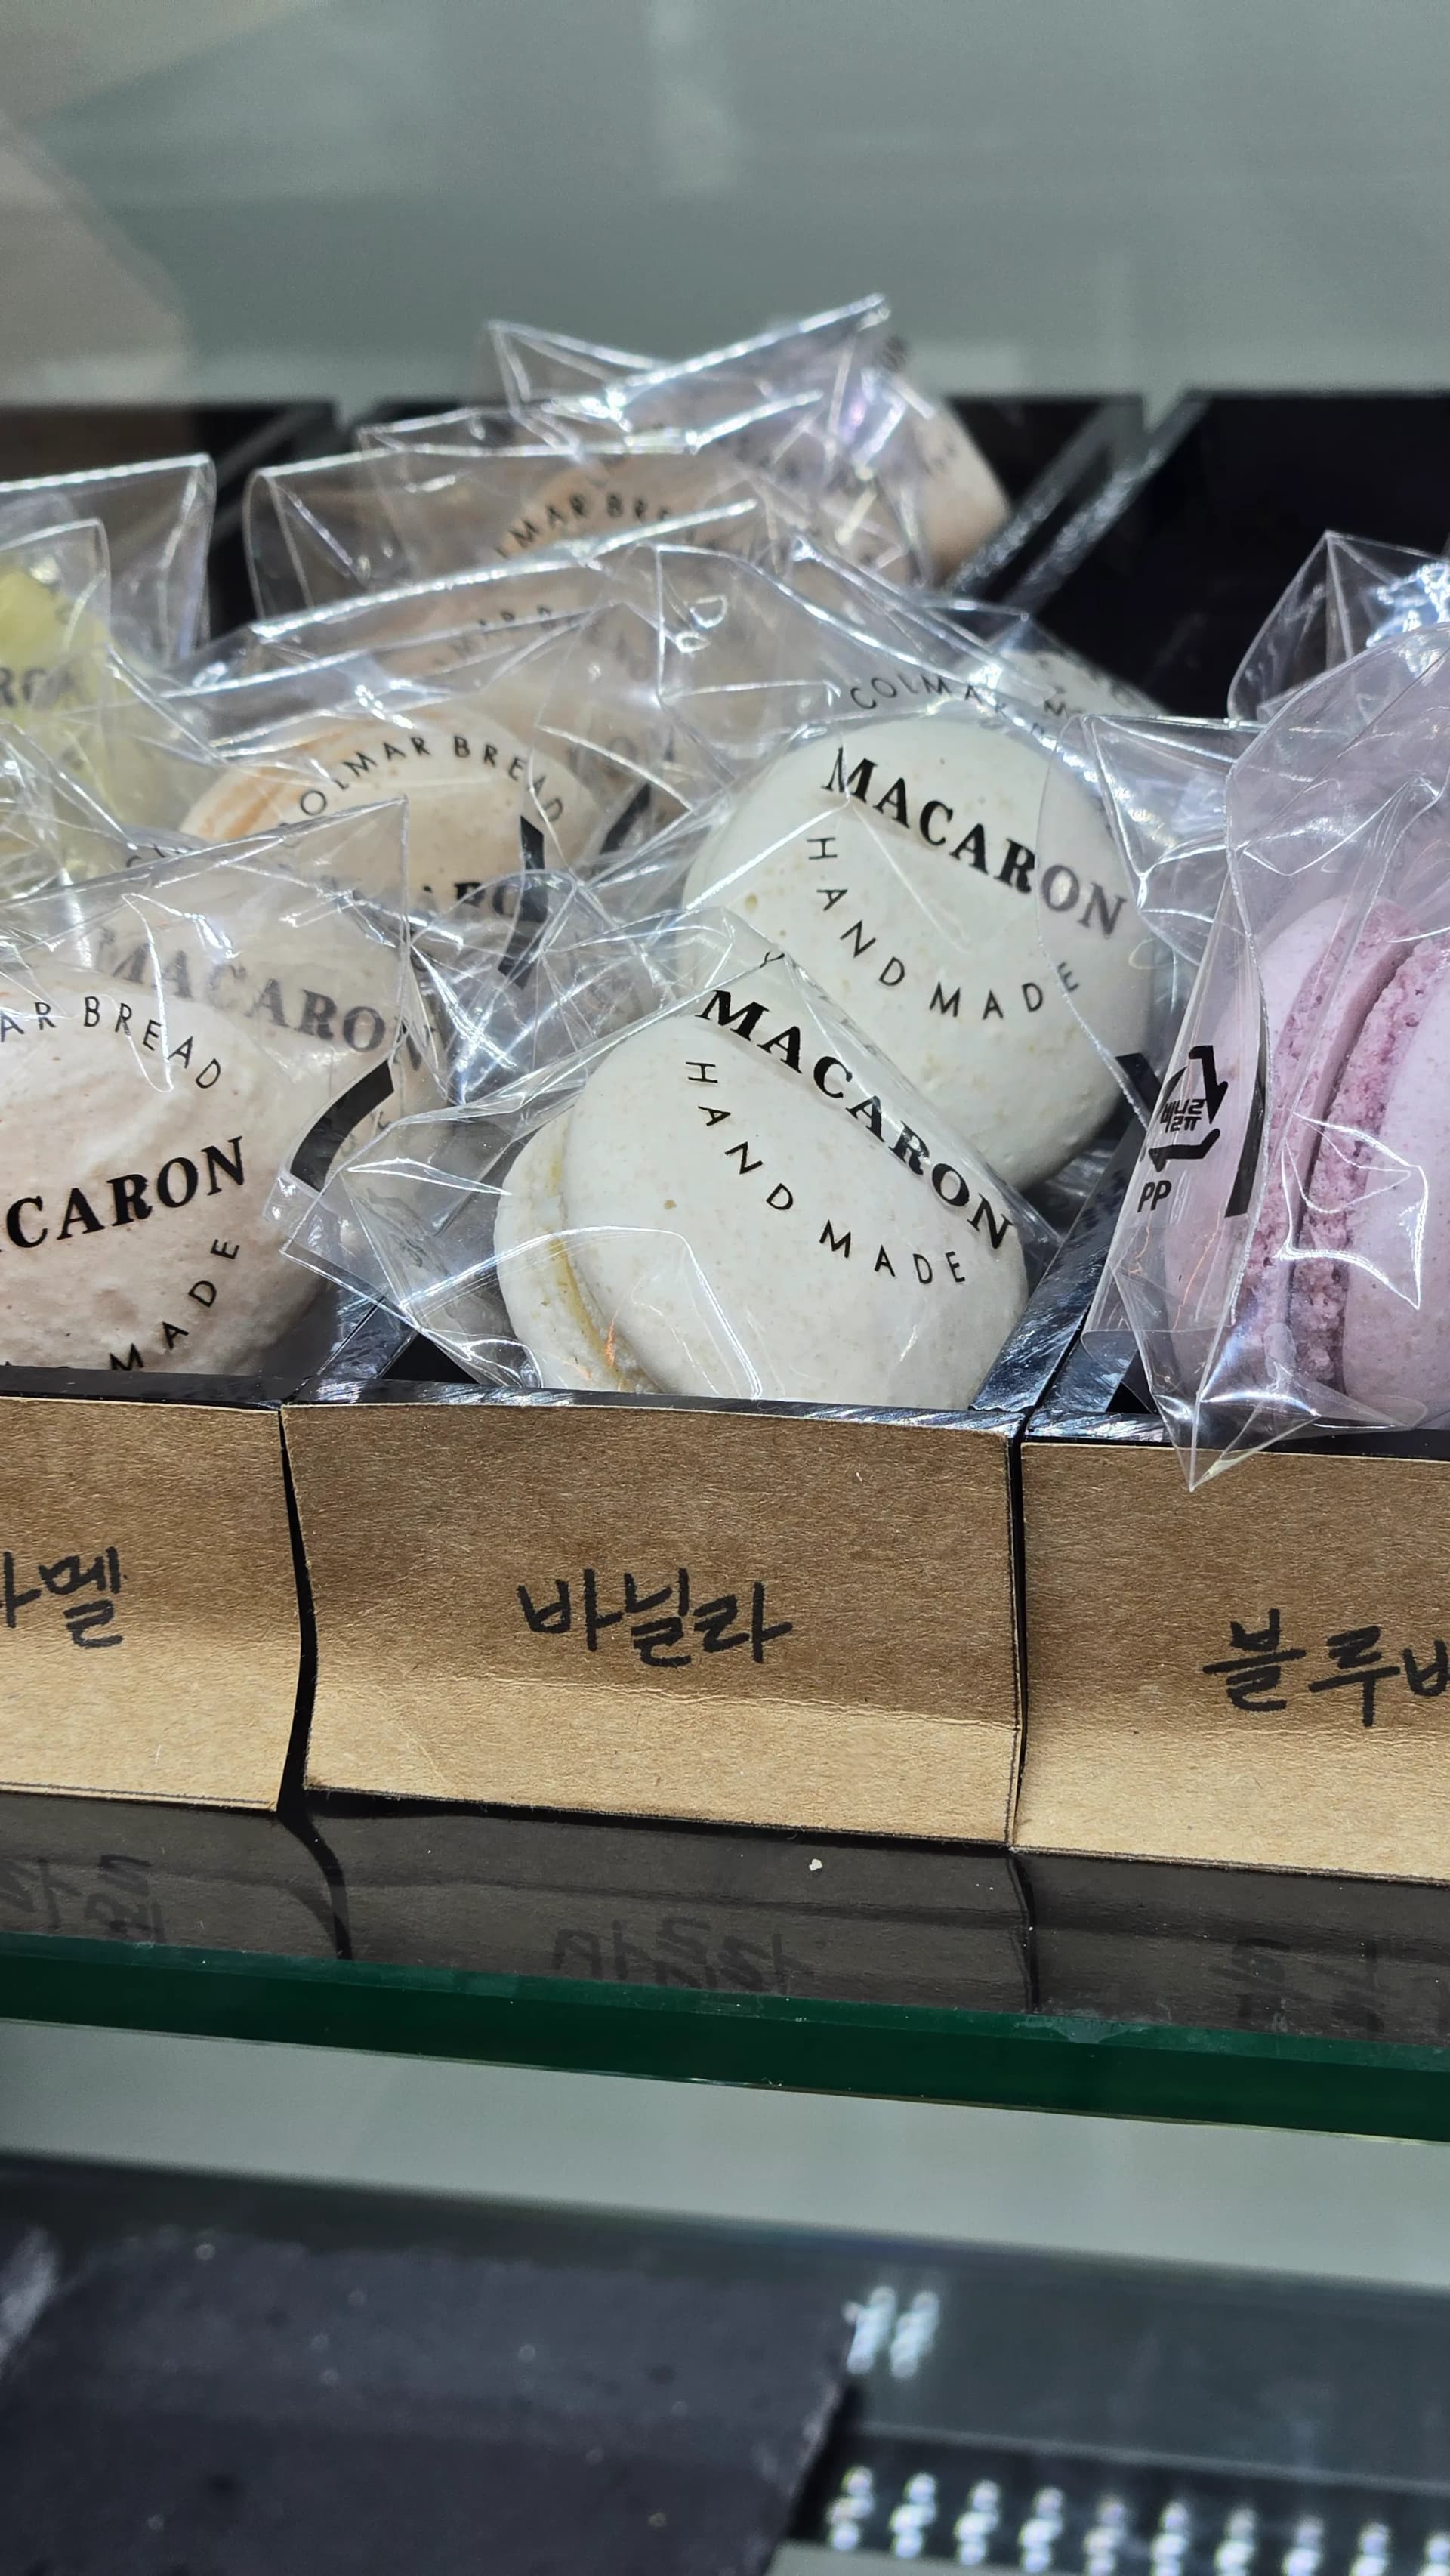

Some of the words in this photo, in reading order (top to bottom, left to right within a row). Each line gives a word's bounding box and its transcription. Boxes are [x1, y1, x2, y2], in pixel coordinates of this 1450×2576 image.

[821, 746, 1128, 939] MACARON
[806, 836, 905, 987] HAND
[929, 962, 1080, 1020] MADE
[83, 996, 221, 1089] BREAD
[695, 989, 1013, 1249] MACARON
[686, 1061, 794, 1212] HAND
[819, 1219, 966, 1284] MADE
[1137, 1180, 1172, 1213] PP
[110, 1239, 240, 1371] MADE
[517, 1567, 793, 1667] 바닐라
